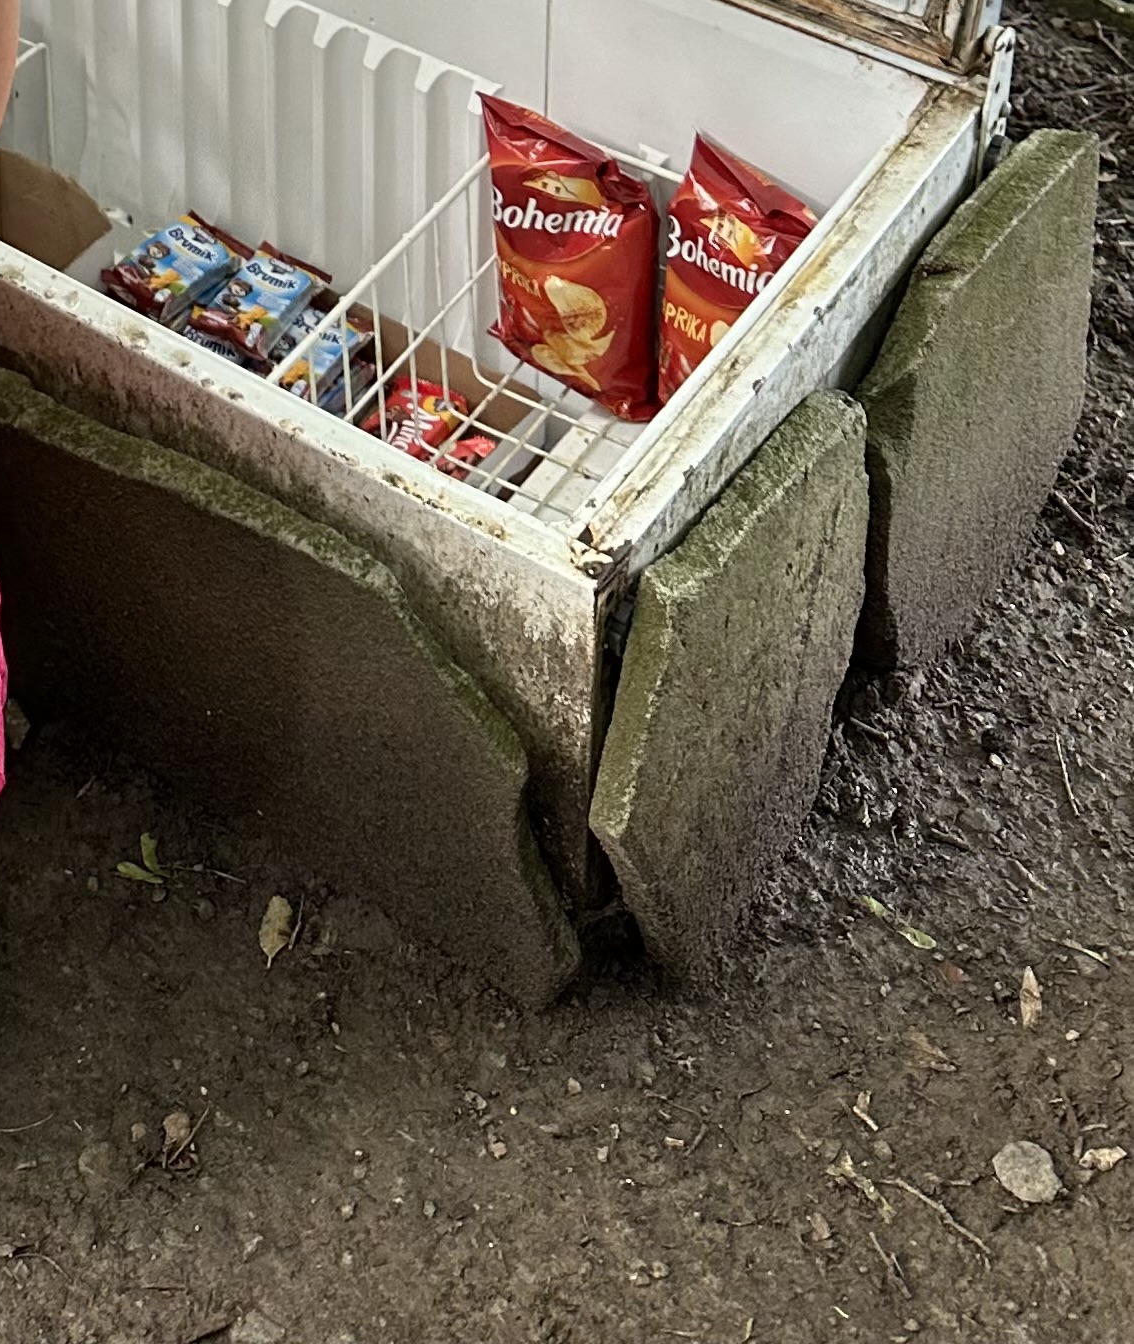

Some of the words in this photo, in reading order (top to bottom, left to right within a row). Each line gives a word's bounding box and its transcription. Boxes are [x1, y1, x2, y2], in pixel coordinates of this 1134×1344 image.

[492, 184, 624, 238] Bohemia
[666, 214, 776, 295] Bohemia
[662, 297, 707, 344] PRIKA
